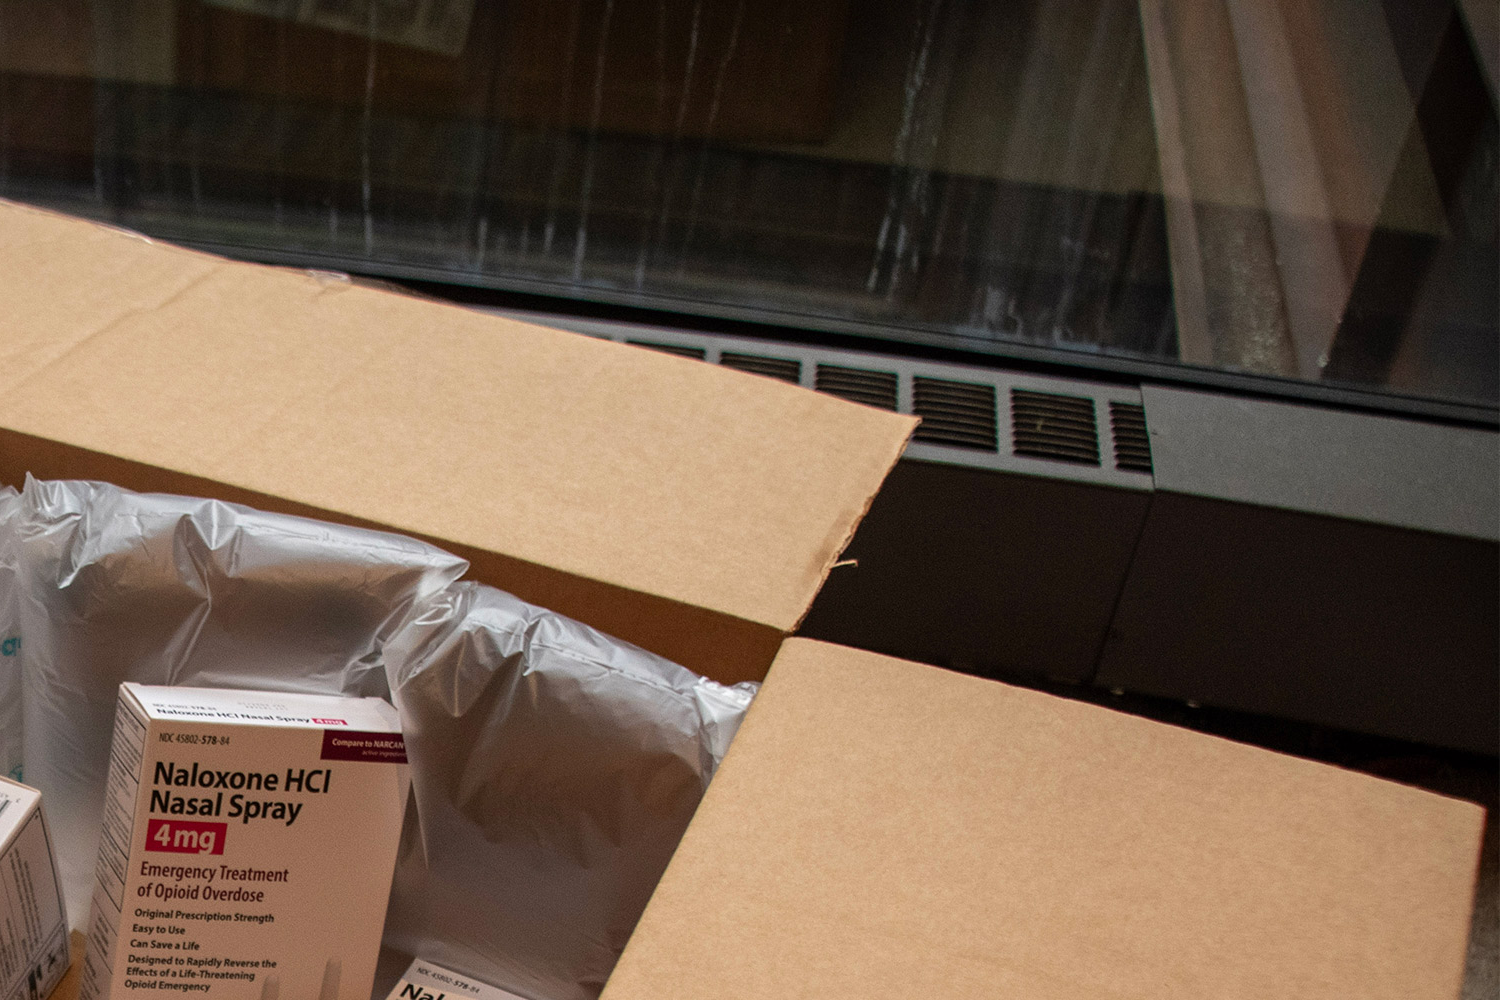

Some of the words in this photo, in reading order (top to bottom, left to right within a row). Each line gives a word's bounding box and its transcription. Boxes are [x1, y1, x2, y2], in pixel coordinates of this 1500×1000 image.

[156, 708, 215, 717] Naloxone
[240, 713, 274, 721] Nasal
[276, 715, 311, 724] Spray
[332, 738, 364, 748] Compare
[364, 740, 373, 748] to
[154, 761, 278, 790] Naloxone
[284, 768, 331, 793] HCl
[149, 790, 222, 816] Nasal
[228, 794, 302, 826] Spray
[141, 861, 216, 882] Emergency
[220, 865, 288, 884] Treatment
[137, 882, 154, 898] of
[154, 883, 199, 901] Opioid
[202, 885, 264, 903] Overdose
[134, 909, 174, 921] Original
[175, 910, 231, 922] Prescription
[234, 913, 274, 925] Strength
[128, 955, 173, 967] Designed
[174, 957, 185, 965] to
[186, 956, 222, 968] Rapidly
[223, 958, 260, 968] Reverse
[261, 960, 277, 969] the
[126, 967, 158, 977] Effects
[159, 968, 170, 978] of
[178, 969, 255, 982] Life-Threatening
[125, 980, 157, 991] Opioid
[158, 980, 210, 992] Emergency
